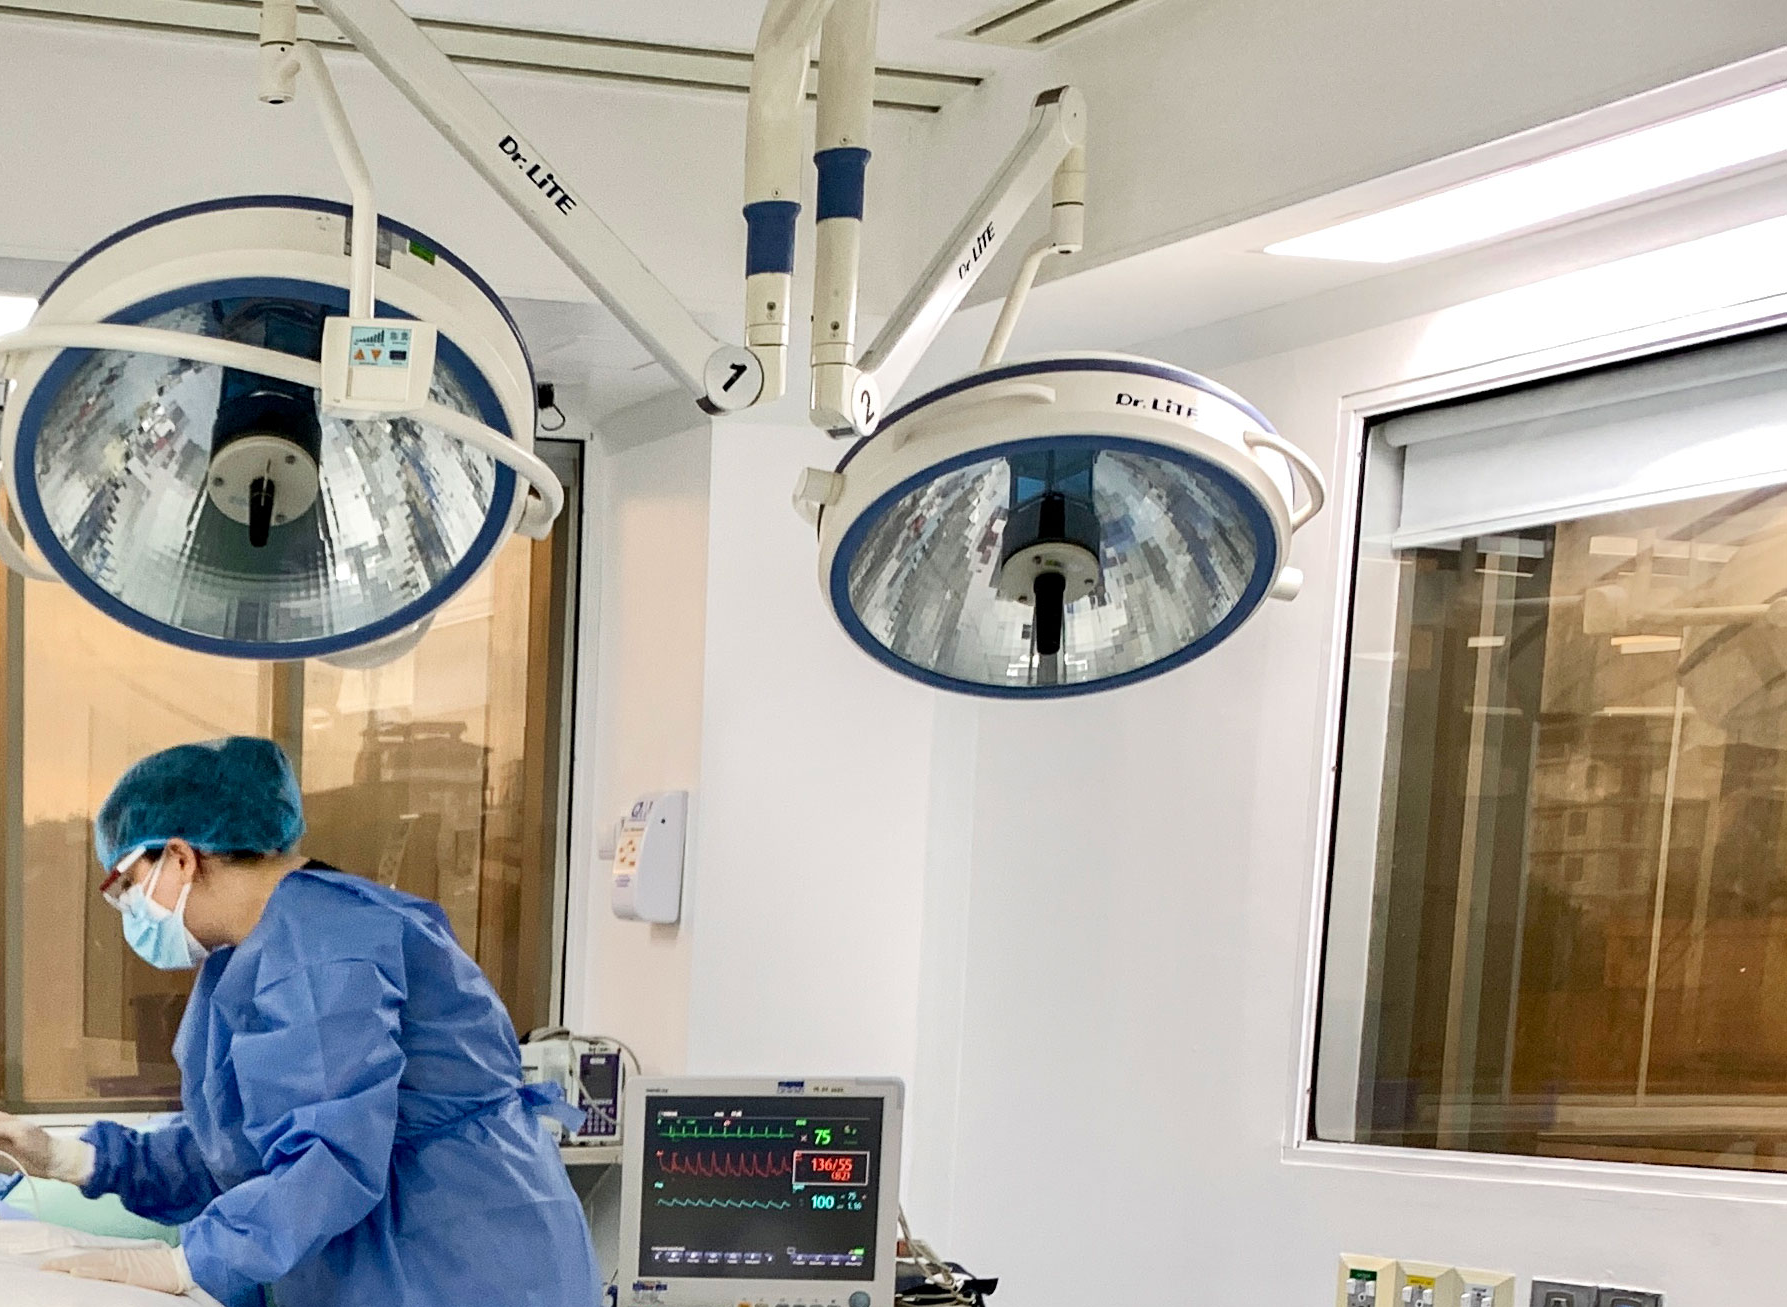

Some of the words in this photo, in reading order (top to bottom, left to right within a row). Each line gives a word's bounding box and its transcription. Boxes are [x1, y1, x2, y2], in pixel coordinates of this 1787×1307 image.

[498, 134, 527, 170] Dr.
[722, 362, 748, 392] 1
[860, 390, 875, 425] 2
[1115, 392, 1145, 409] Dr.
[814, 1128, 832, 1146] 75
[811, 1157, 853, 1172] 136/55
[811, 1194, 835, 1209] 100
